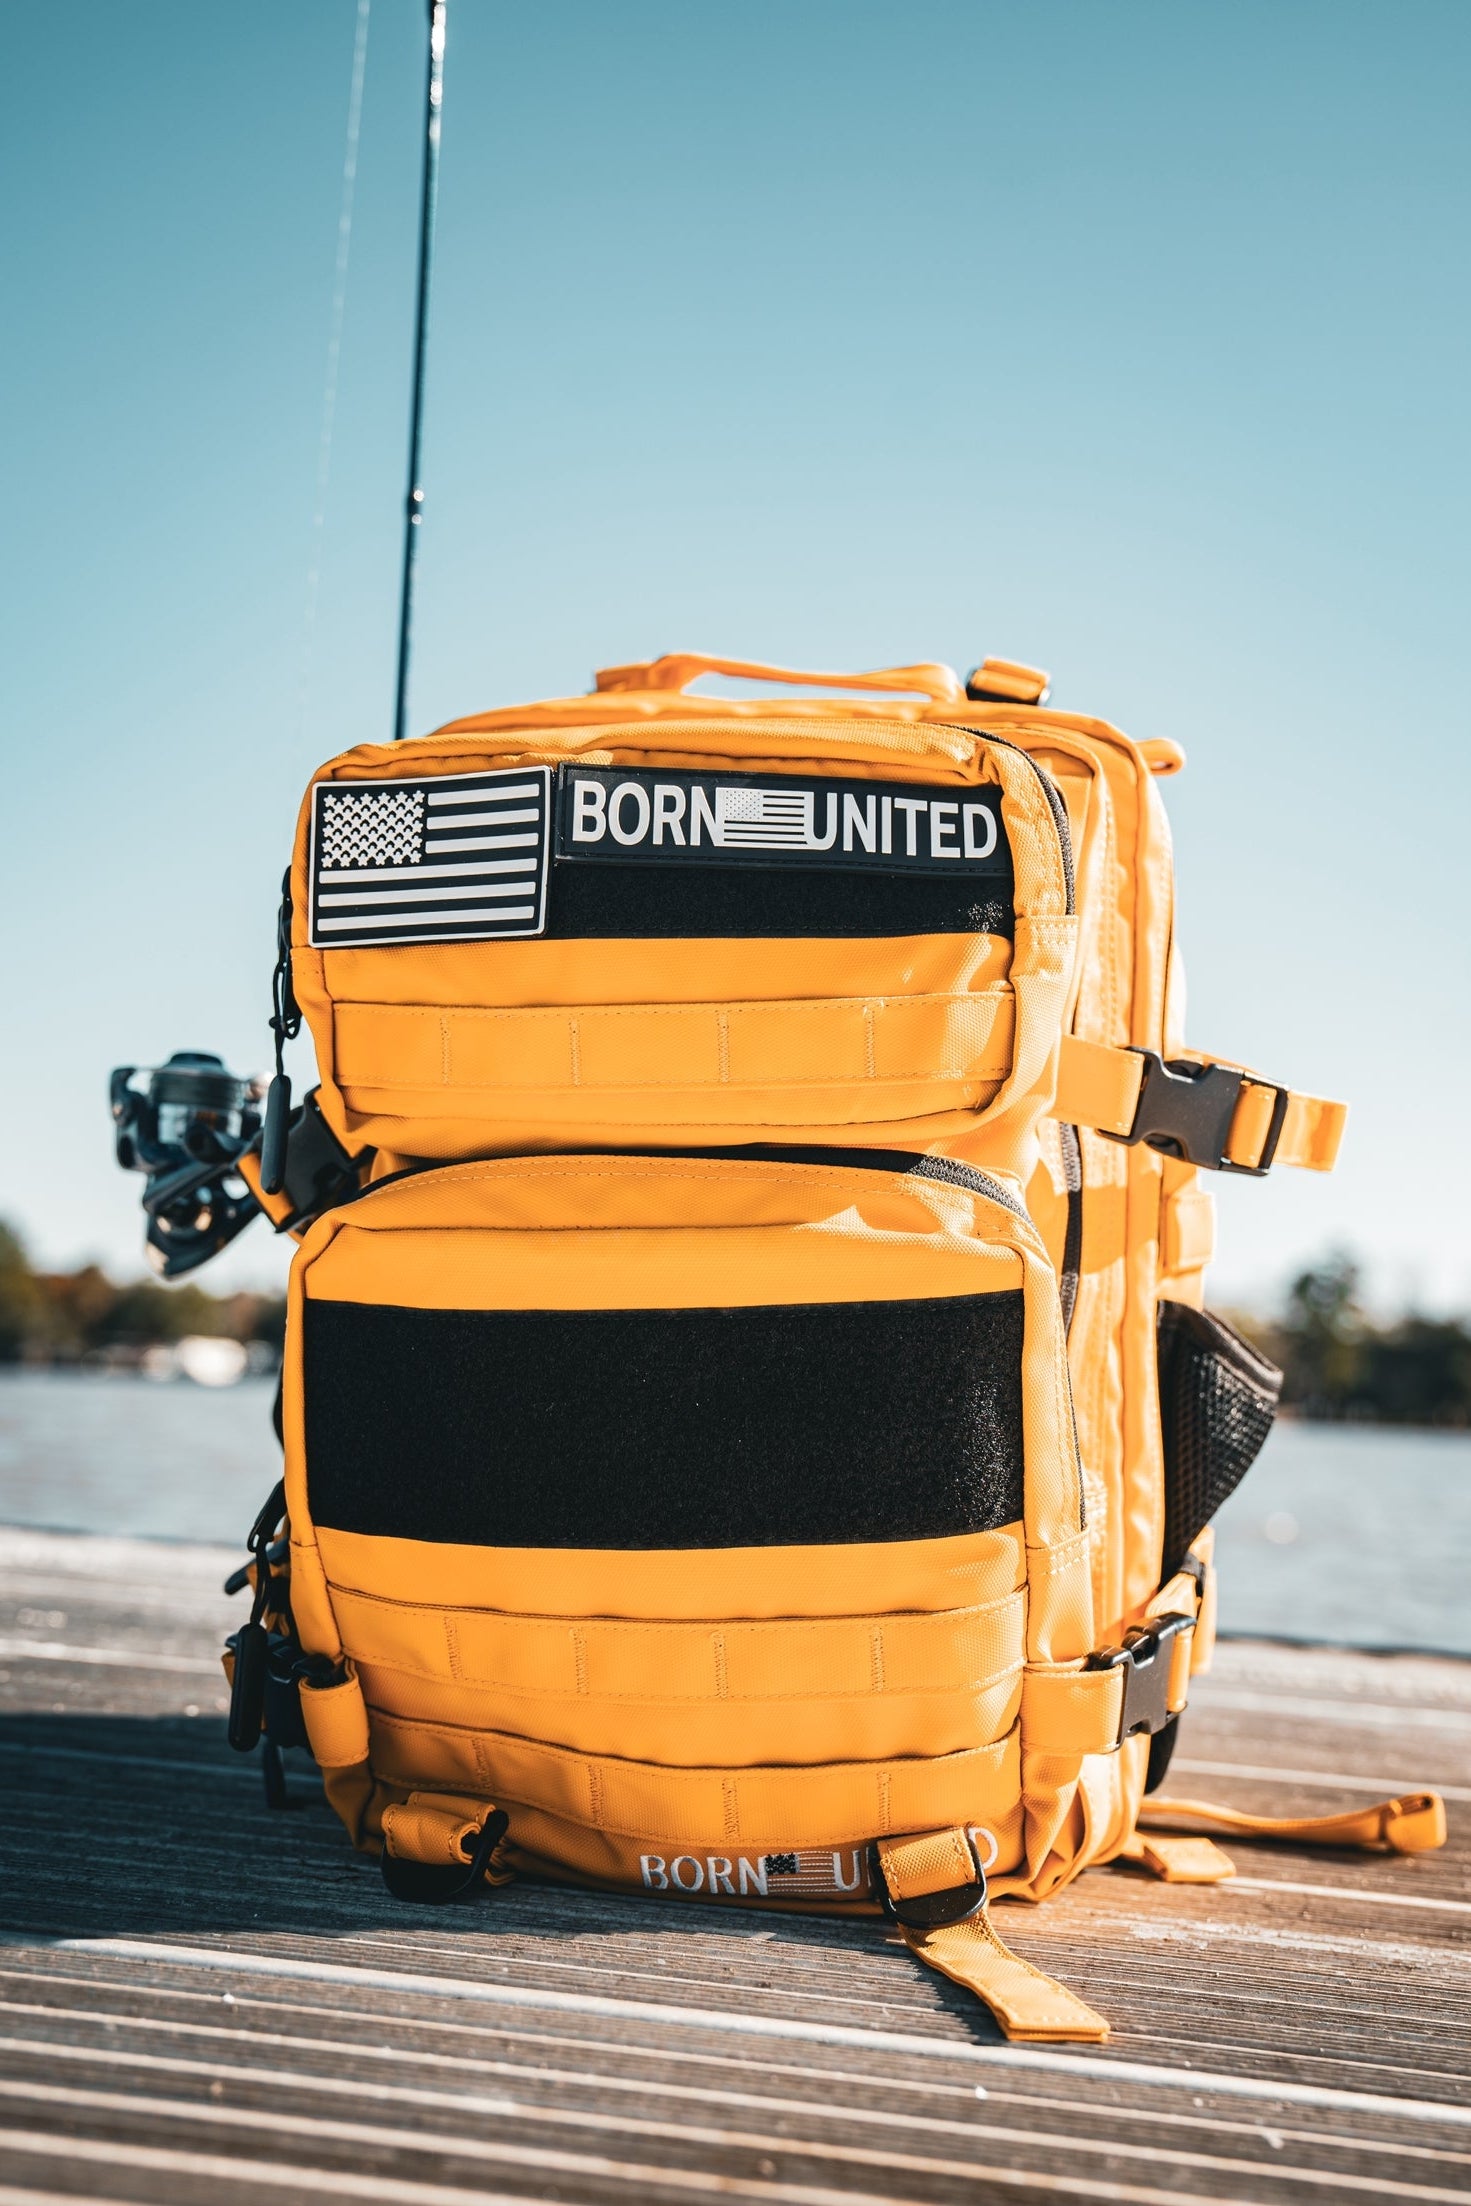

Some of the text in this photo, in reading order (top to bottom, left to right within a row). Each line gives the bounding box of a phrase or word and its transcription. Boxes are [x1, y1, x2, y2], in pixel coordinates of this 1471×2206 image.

[571, 779, 998, 859] BORN UNITED
[639, 1854, 769, 1896] BORN
